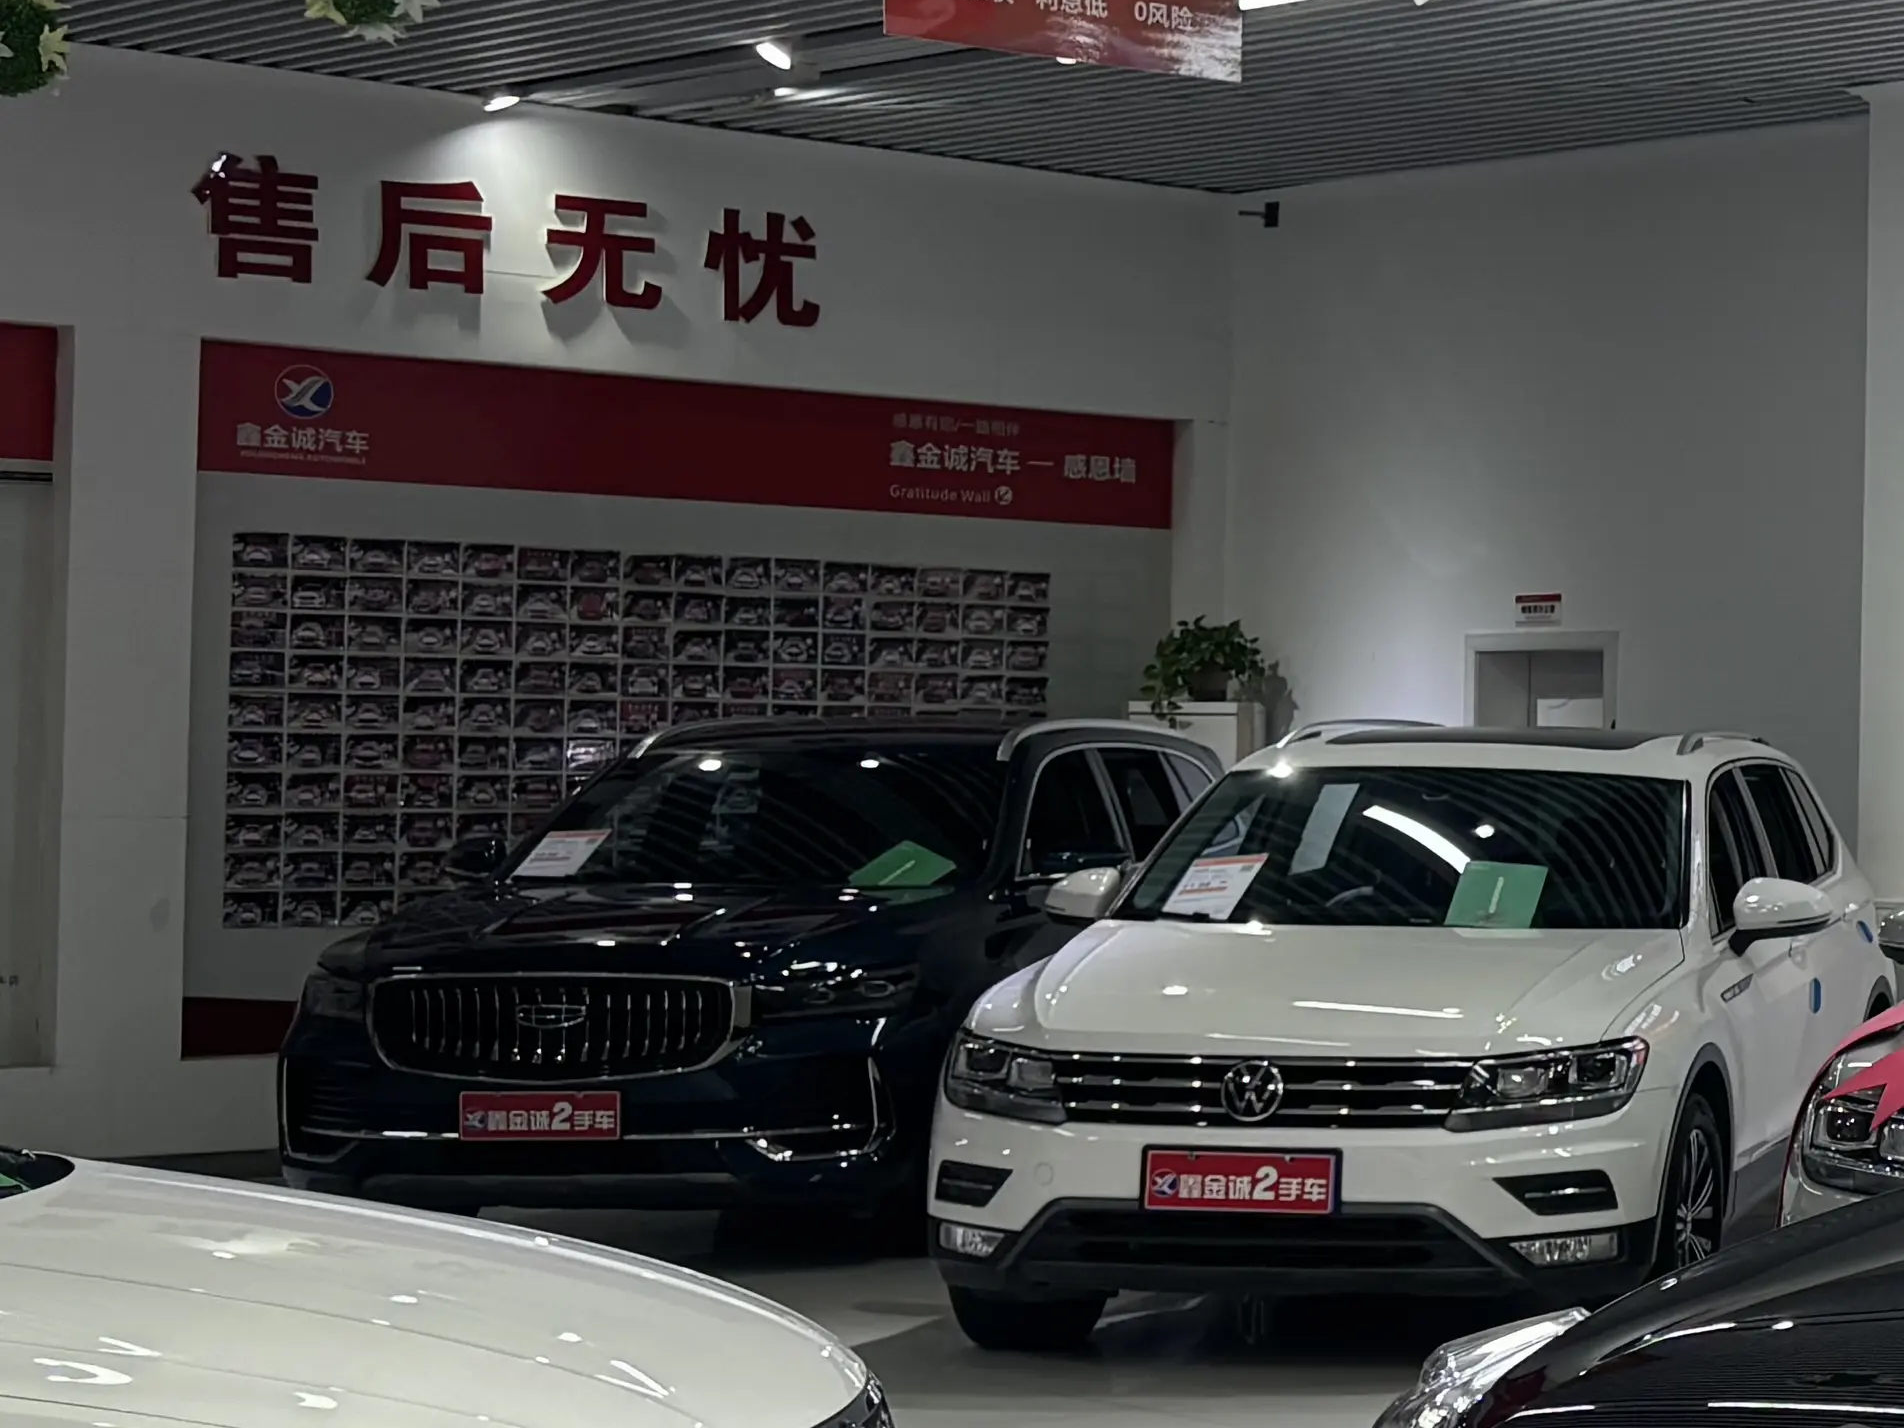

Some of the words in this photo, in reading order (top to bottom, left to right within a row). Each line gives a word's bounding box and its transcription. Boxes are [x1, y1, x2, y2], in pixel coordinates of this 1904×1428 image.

[1134, 0, 1194, 30] 0风险
[190, 151, 821, 328] 售后无忧
[235, 422, 370, 454] 鑫金诚汽车
[889, 483, 957, 502] Gratitude
[960, 488, 990, 504] Wall
[487, 1101, 615, 1131] 鑫金诚2手车
[1178, 1165, 1327, 1202] 鑫金诚2手车
